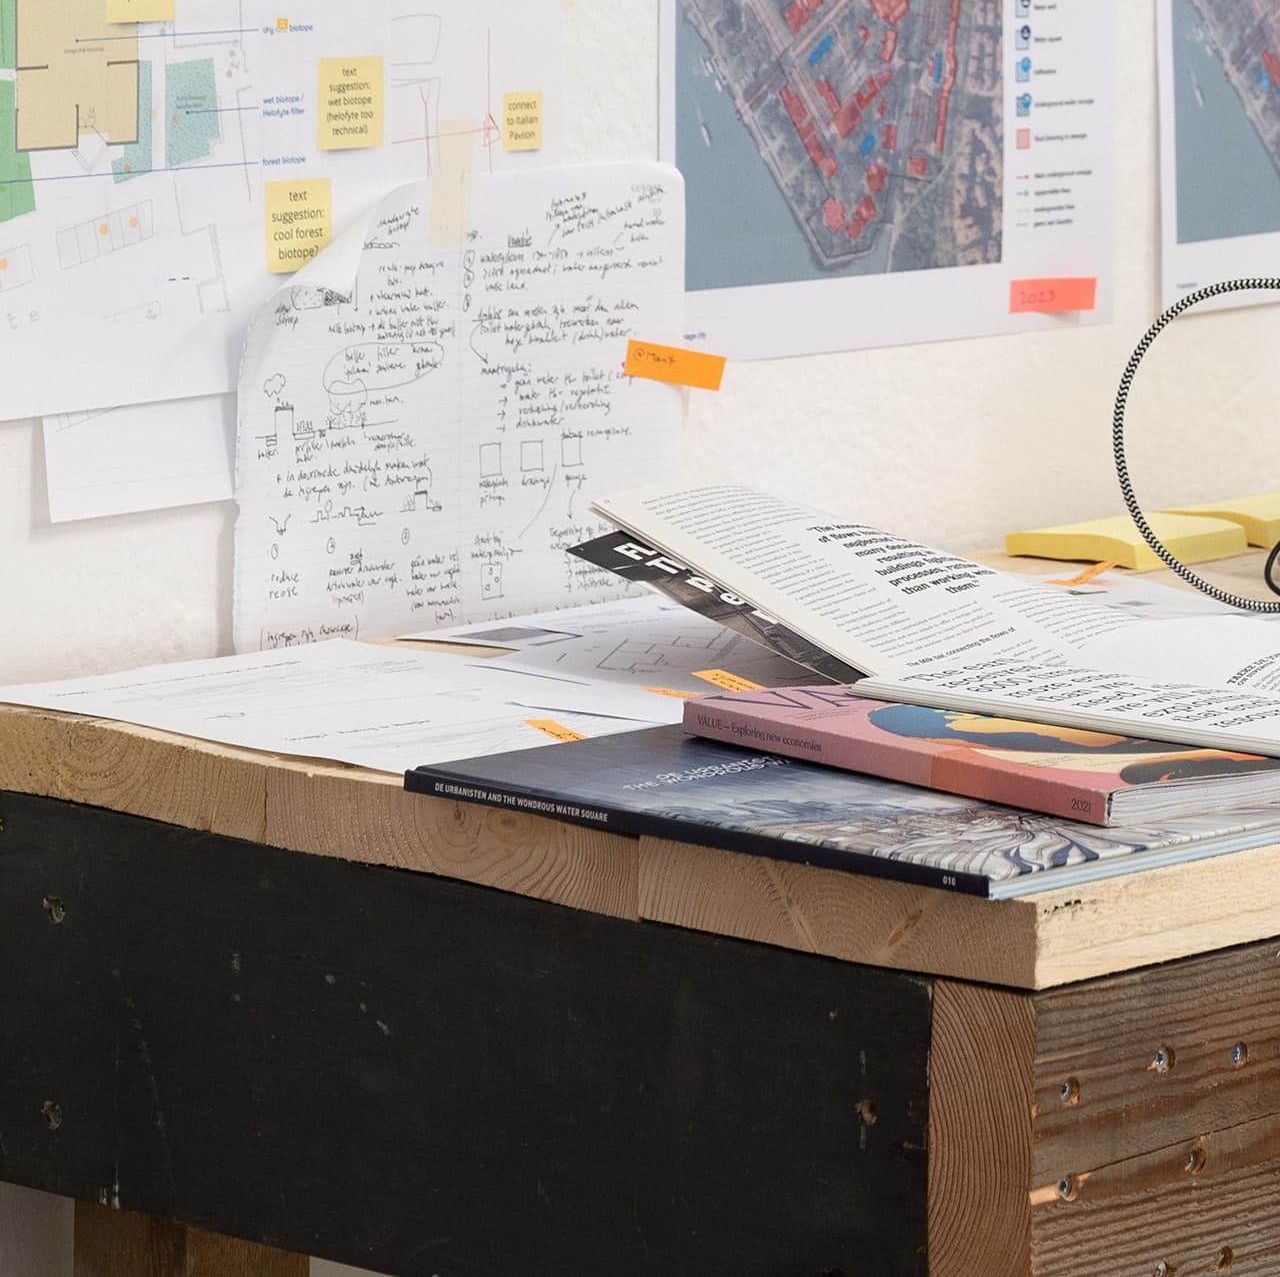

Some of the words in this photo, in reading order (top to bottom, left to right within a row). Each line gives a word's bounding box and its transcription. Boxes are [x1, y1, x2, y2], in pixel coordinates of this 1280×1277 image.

[263, 25, 274, 35] dry
[289, 23, 314, 34] biotope
[342, 68, 357, 78] text
[329, 82, 371, 94] suggestion:
[275, 94, 297, 106] biotope
[328, 96, 341, 106] wet
[343, 93, 372, 107] biotope
[508, 100, 537, 111] connect
[326, 110, 358, 123] (helofyte
[360, 110, 374, 121] too
[506, 116, 517, 126] to
[516, 115, 539, 126] Italian
[332, 124, 368, 137] technical)
[262, 158, 281, 168] forest
[282, 155, 306, 166] biotope
[289, 190, 308, 202] text
[272, 208, 325, 224] suggestion:
[273, 228, 294, 240] cool
[295, 226, 323, 239] forest
[278, 245, 319, 261] biotope?
[818, 534, 830, 544] of
[855, 545, 886, 558] many
[875, 559, 924, 576] buildings
[901, 583, 930, 595] than
[930, 572, 976, 588] working
[697, 714, 723, 731] VALUE
[731, 724, 766, 742] Exploring
[766, 733, 782, 744] new
[782, 736, 822, 753] economies
[434, 782, 444, 792] DE
[445, 784, 488, 802] URBANISTEN
[487, 792, 502, 803] AND
[503, 794, 516, 806] THE
[517, 796, 556, 813] WONDROUS
[556, 803, 580, 817] WATER
[581, 807, 609, 823] SQUARE
[1071, 798, 1092, 814] 2021
